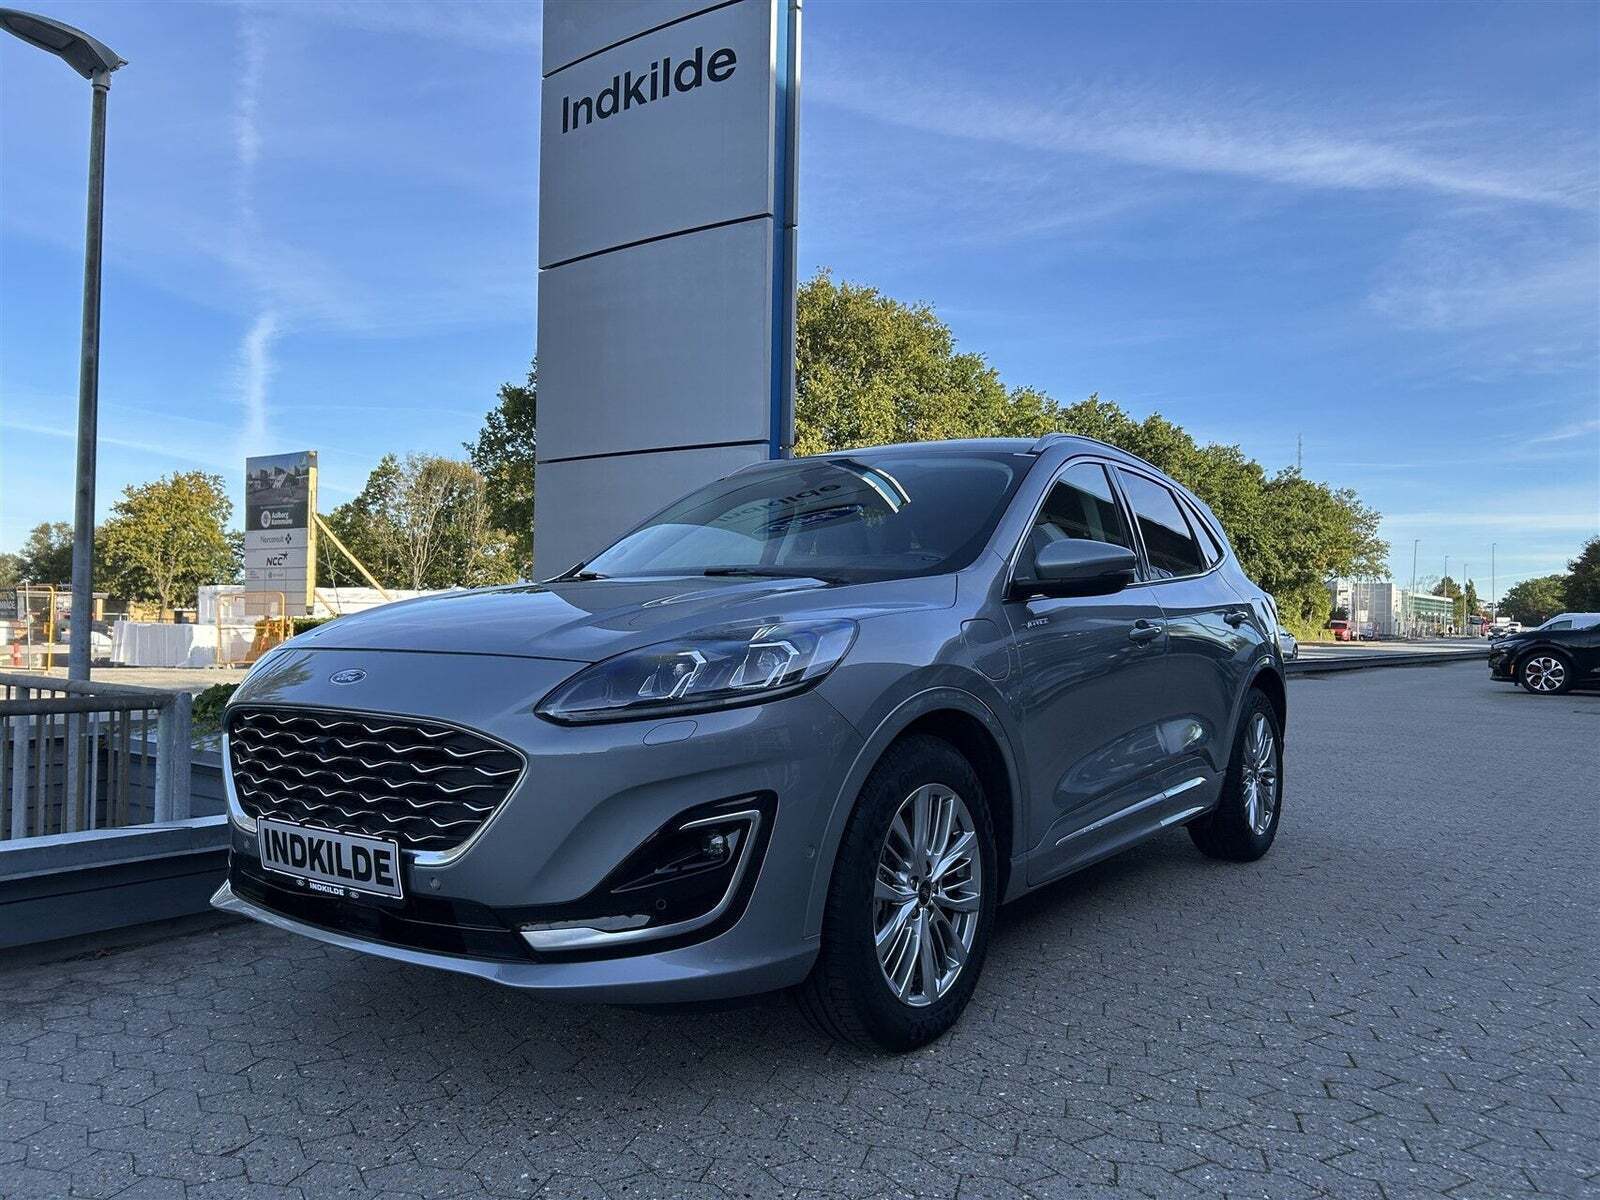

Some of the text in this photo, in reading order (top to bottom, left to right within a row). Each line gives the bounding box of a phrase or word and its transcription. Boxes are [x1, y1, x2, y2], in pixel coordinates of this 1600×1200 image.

[562, 46, 737, 134] Indkilde
[266, 557, 283, 566] NCC
[264, 828, 394, 887] INDKILDE
[309, 882, 345, 896] INDKILDE
